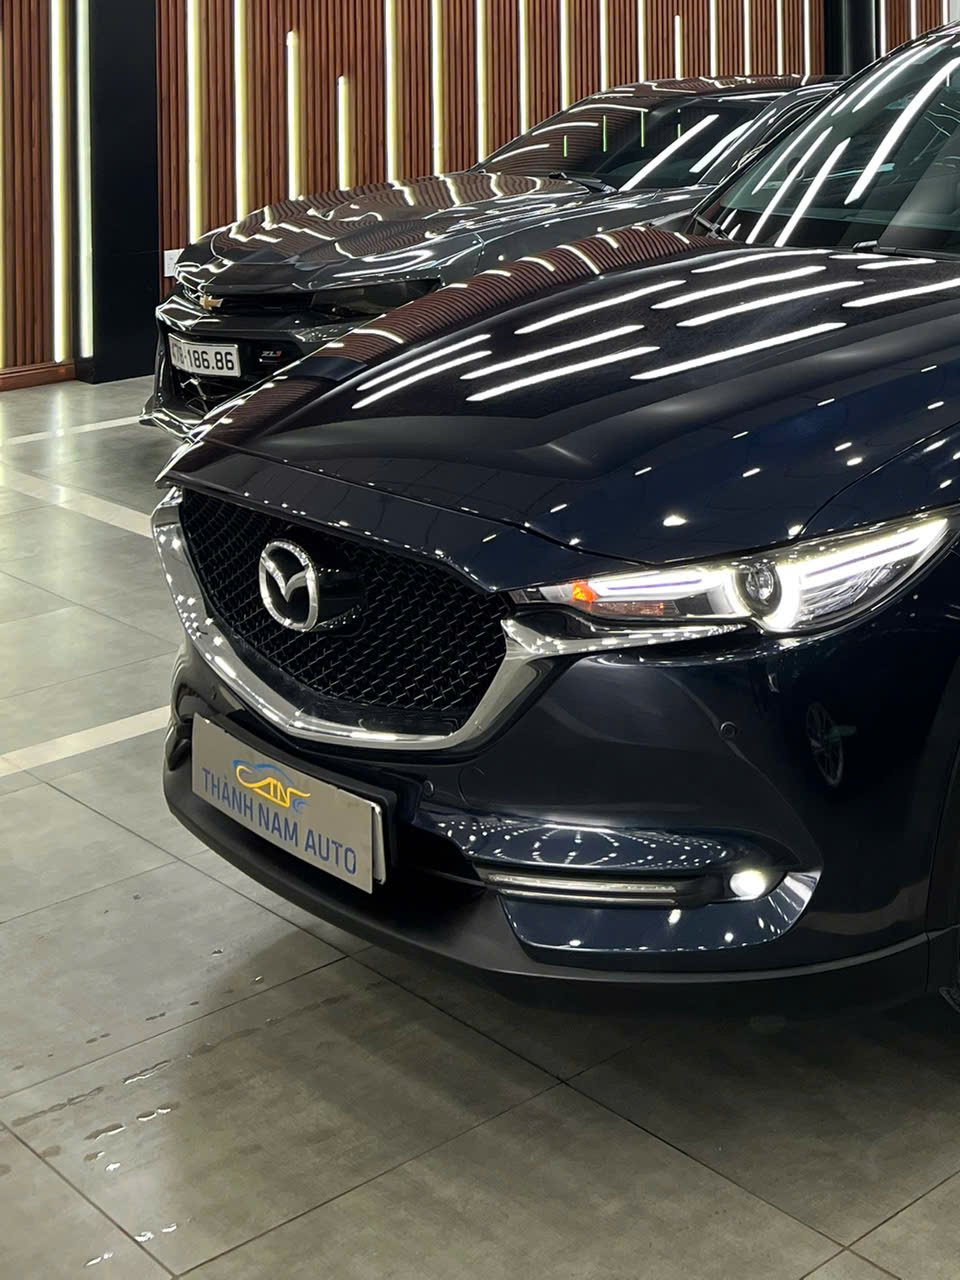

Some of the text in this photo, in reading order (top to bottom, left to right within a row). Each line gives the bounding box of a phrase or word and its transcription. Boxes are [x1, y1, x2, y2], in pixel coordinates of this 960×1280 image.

[202, 768, 357, 875] THÀNH NAM AUTO
